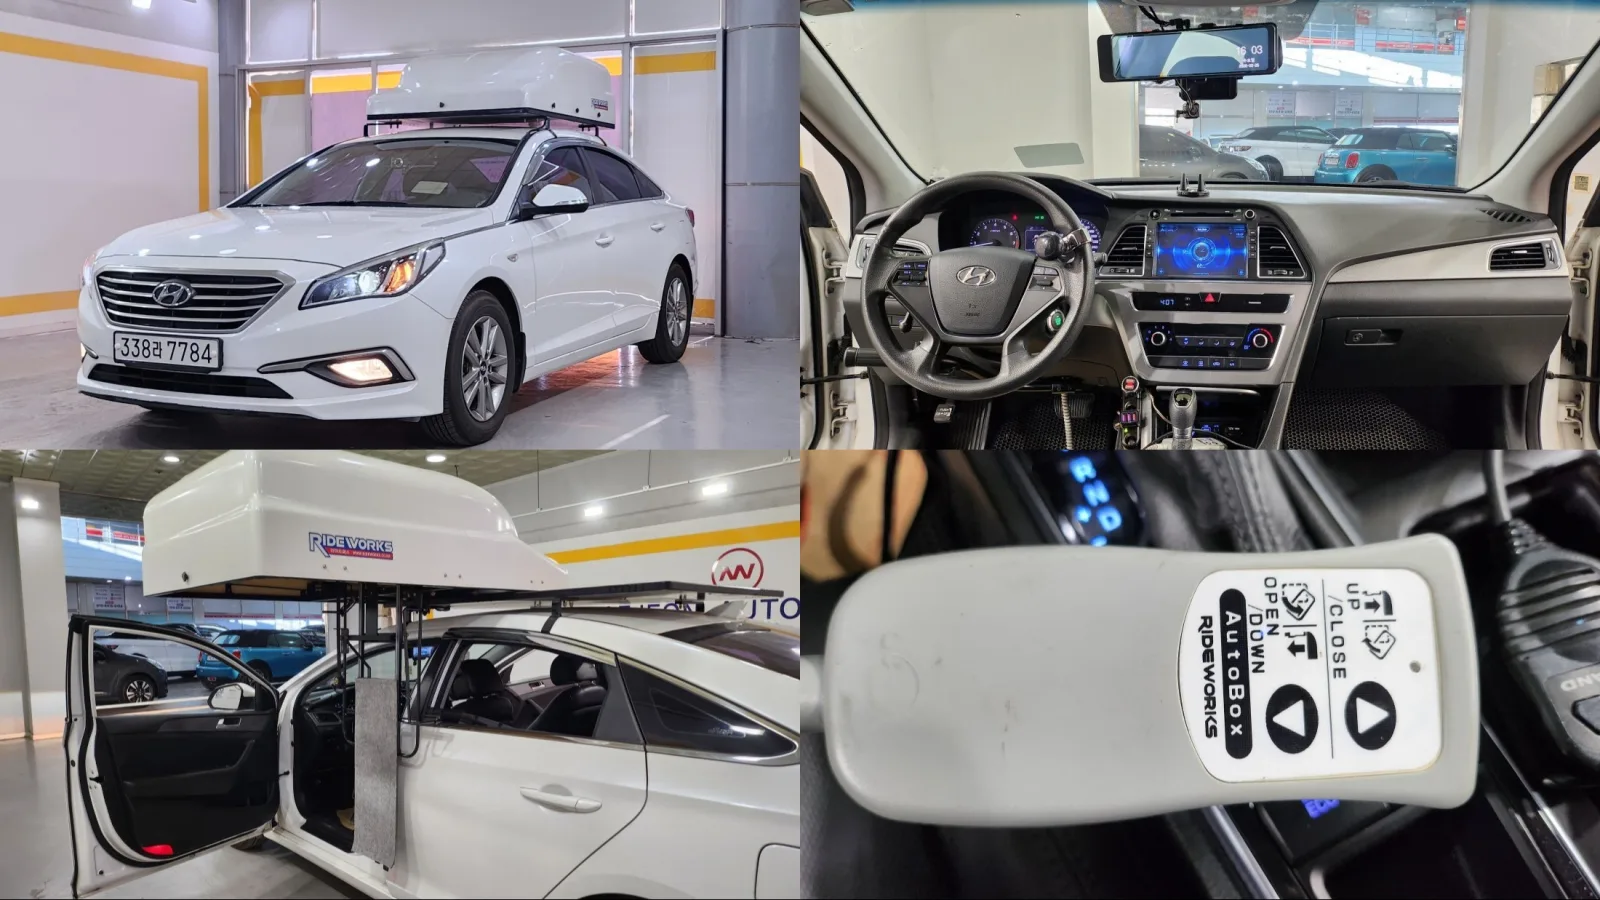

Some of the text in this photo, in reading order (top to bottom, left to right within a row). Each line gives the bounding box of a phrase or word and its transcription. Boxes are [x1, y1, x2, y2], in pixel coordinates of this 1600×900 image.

[1251, 45, 1263, 54] 03
[121, 337, 212, 364] 338라 7784
[308, 531, 394, 558] RIDEWORKS
[1262, 576, 1280, 636] OPEN
[1345, 582, 1361, 610] UP
[1197, 614, 1218, 740] RIDEWORKS
[1224, 609, 1244, 736] AutoBox
